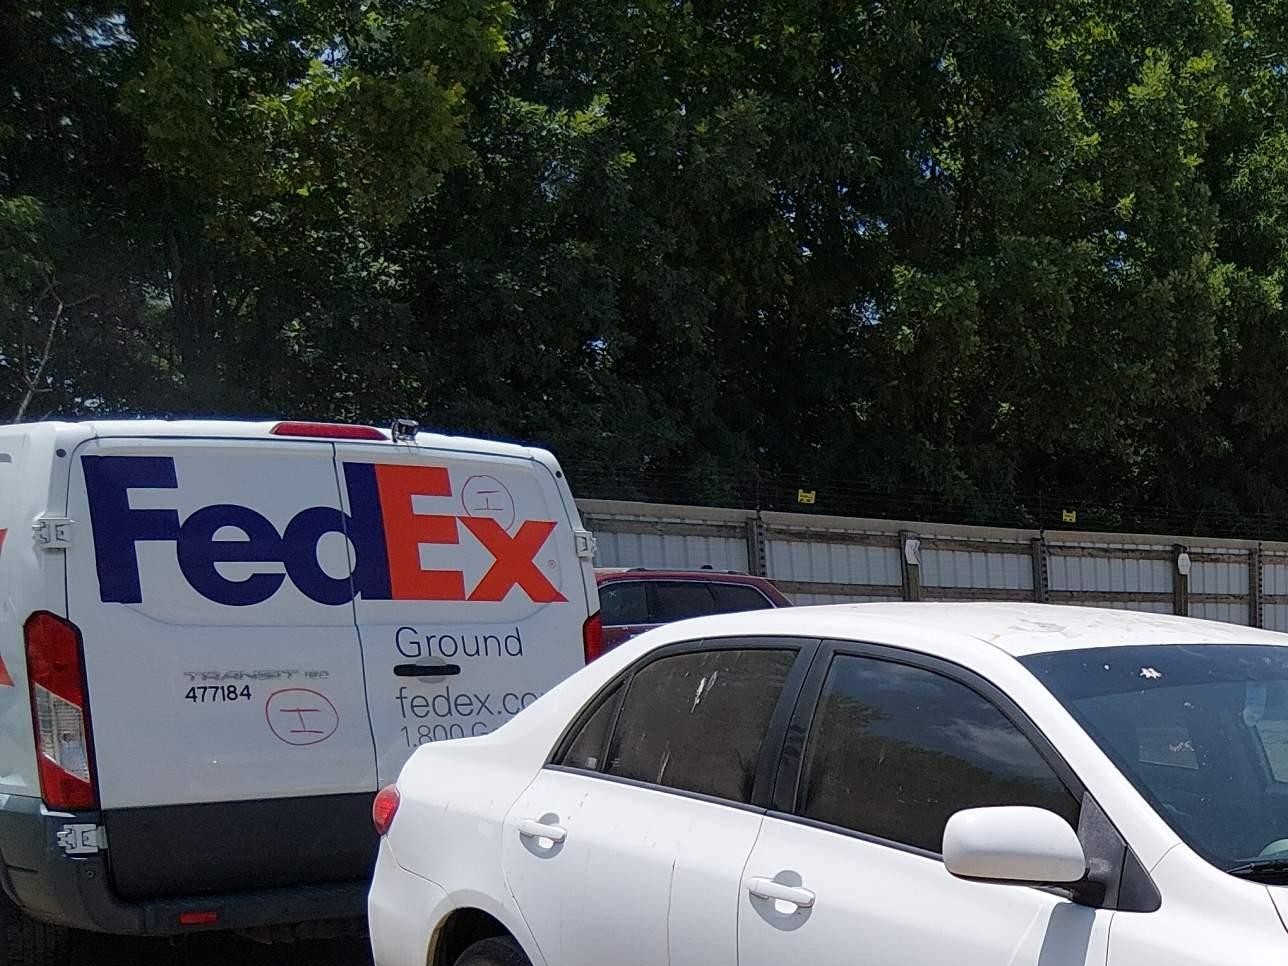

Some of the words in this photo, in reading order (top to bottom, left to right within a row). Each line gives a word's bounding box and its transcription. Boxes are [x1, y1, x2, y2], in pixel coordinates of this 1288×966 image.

[80, 455, 569, 606] FedEx
[395, 626, 523, 658] Ground
[184, 669, 299, 681] TRANSIT
[185, 684, 251, 703] 477184
[395, 686, 547, 719] fedex.co
